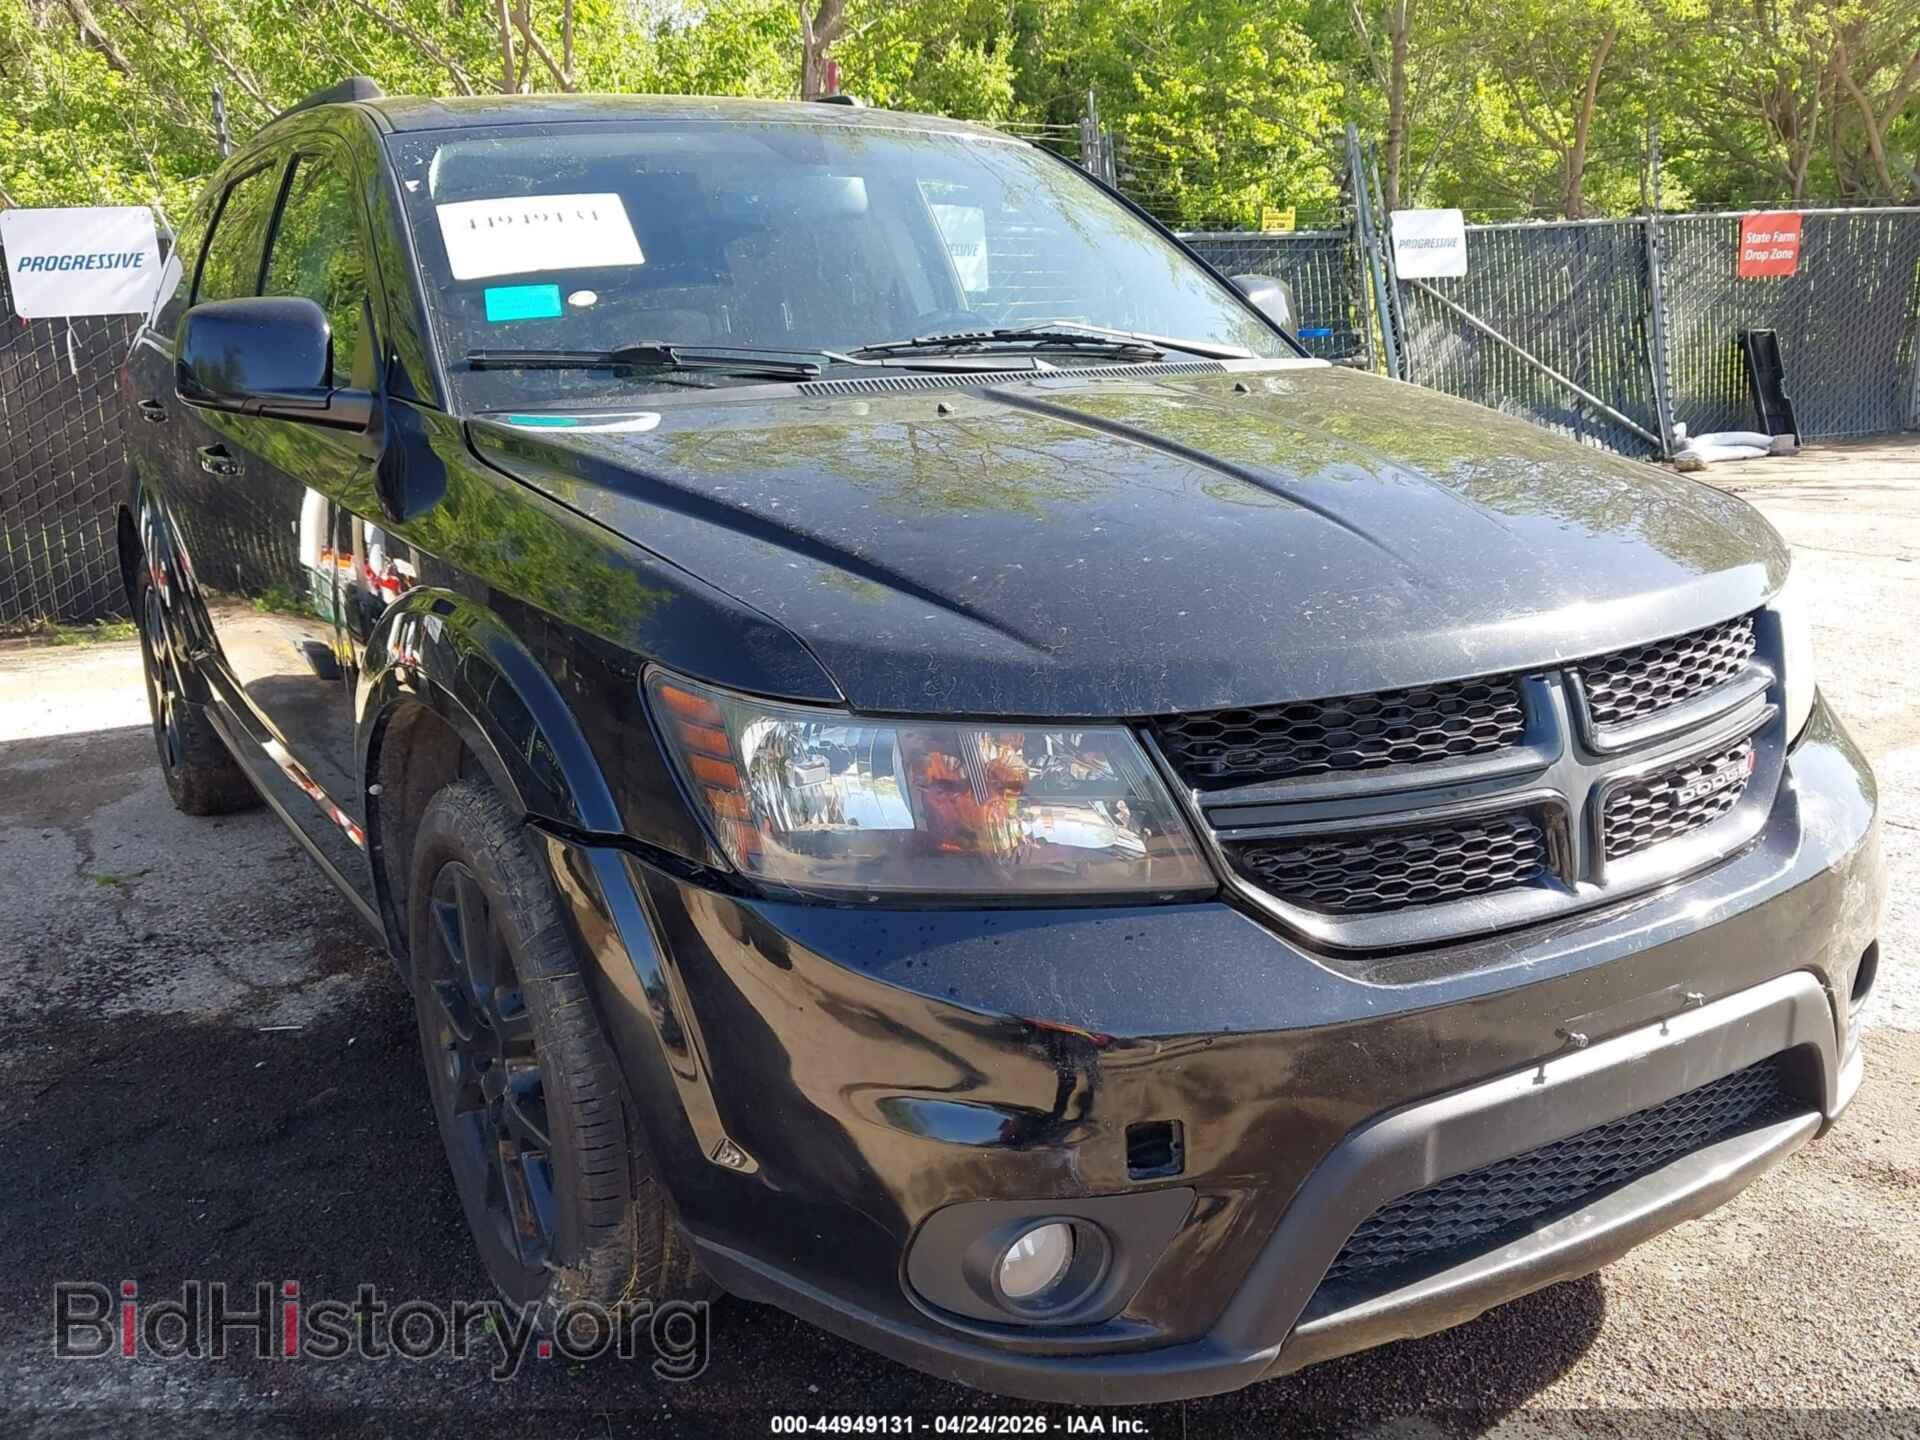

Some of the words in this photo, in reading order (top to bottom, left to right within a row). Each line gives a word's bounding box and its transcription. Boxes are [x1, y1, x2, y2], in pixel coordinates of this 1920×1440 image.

[1746, 231, 1771, 244] State
[1772, 230, 1796, 243] Farm
[17, 252, 145, 273] PROGRESSIVE
[1744, 248, 1769, 264] Drop
[1770, 248, 1794, 260] Zone
[1678, 765, 1749, 804] DODGE
